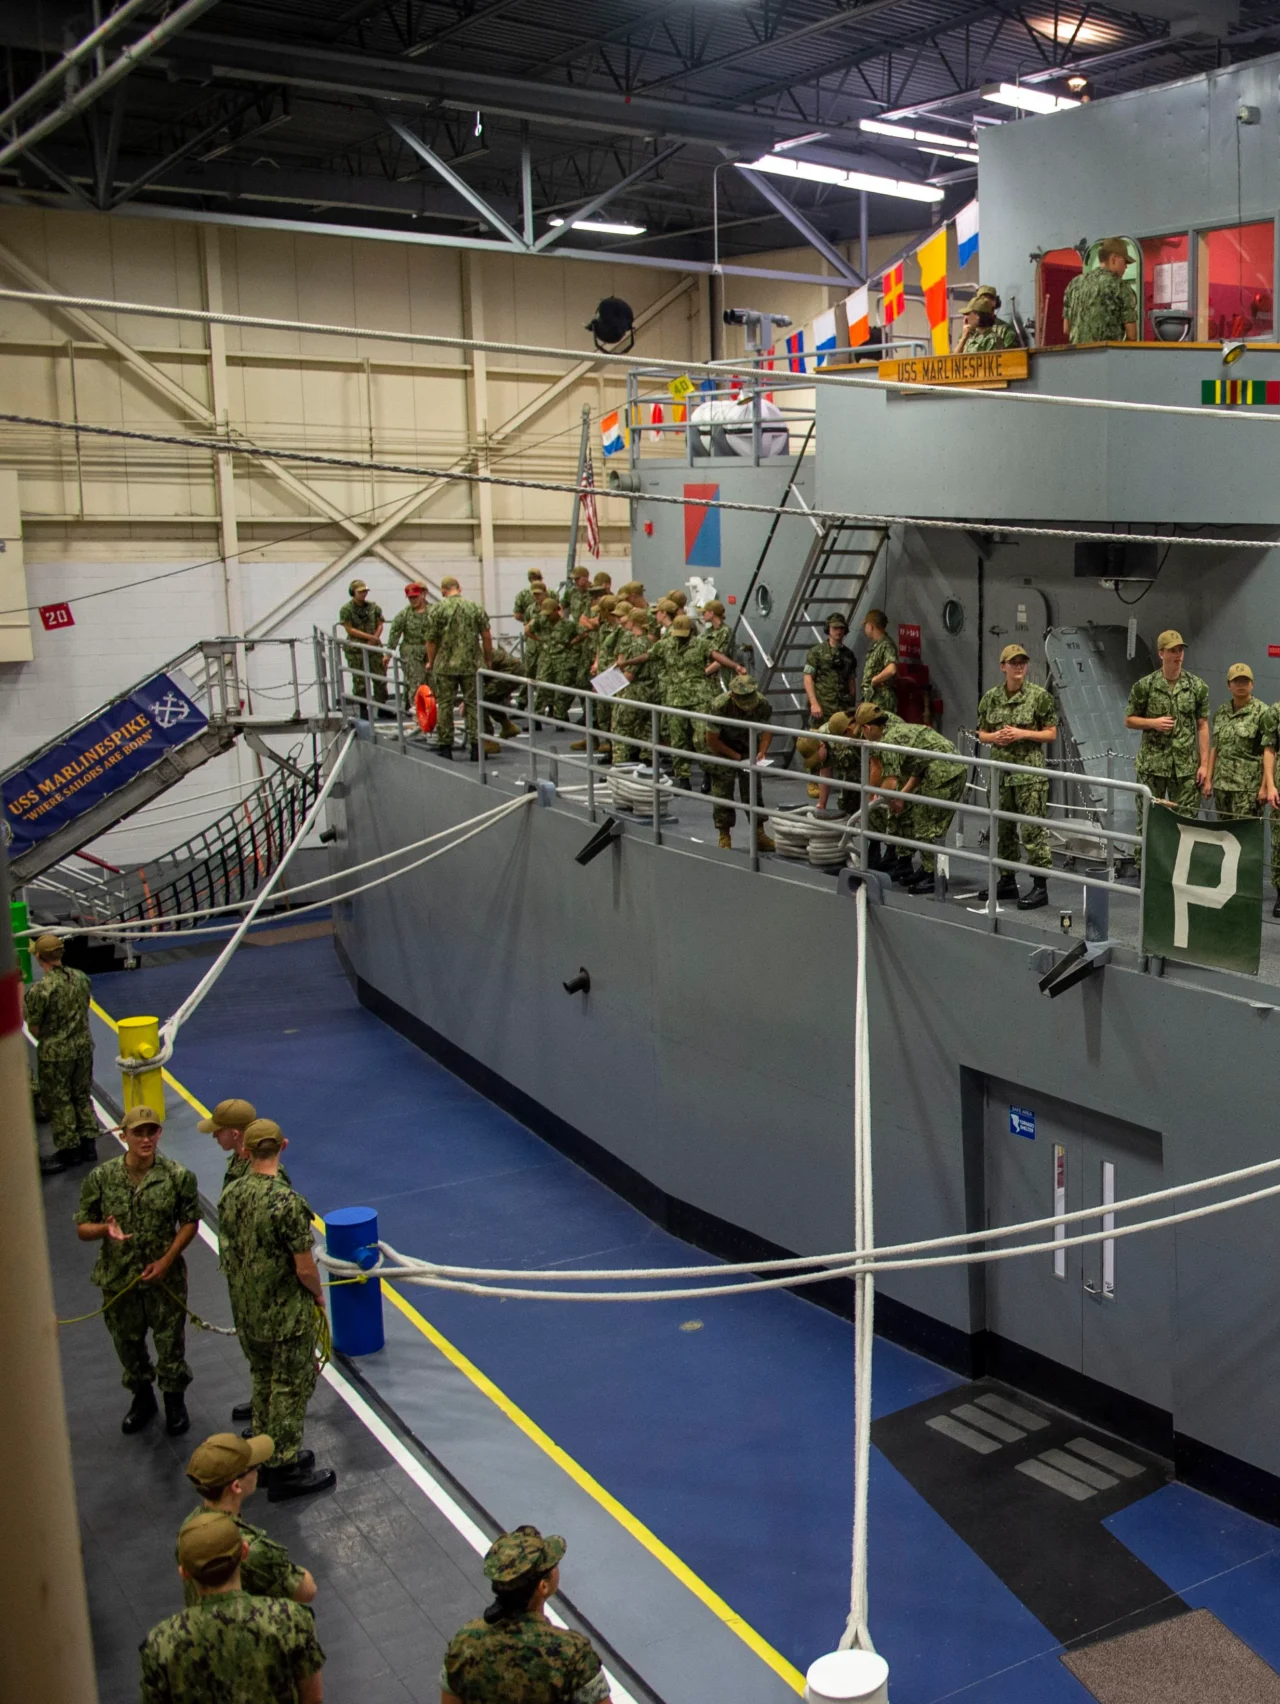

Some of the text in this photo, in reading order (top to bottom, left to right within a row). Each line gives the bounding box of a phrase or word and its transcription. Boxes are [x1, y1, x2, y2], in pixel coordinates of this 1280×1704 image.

[675, 380, 689, 394] 40
[897, 354, 1003, 382] USS MARLINESPIKE
[45, 609, 69, 625] 20
[8, 713, 150, 815] USS MARLINESPIKE
[22, 728, 153, 820] "WHERE SAILORS ARE BORN"
[1172, 823, 1242, 949] P
